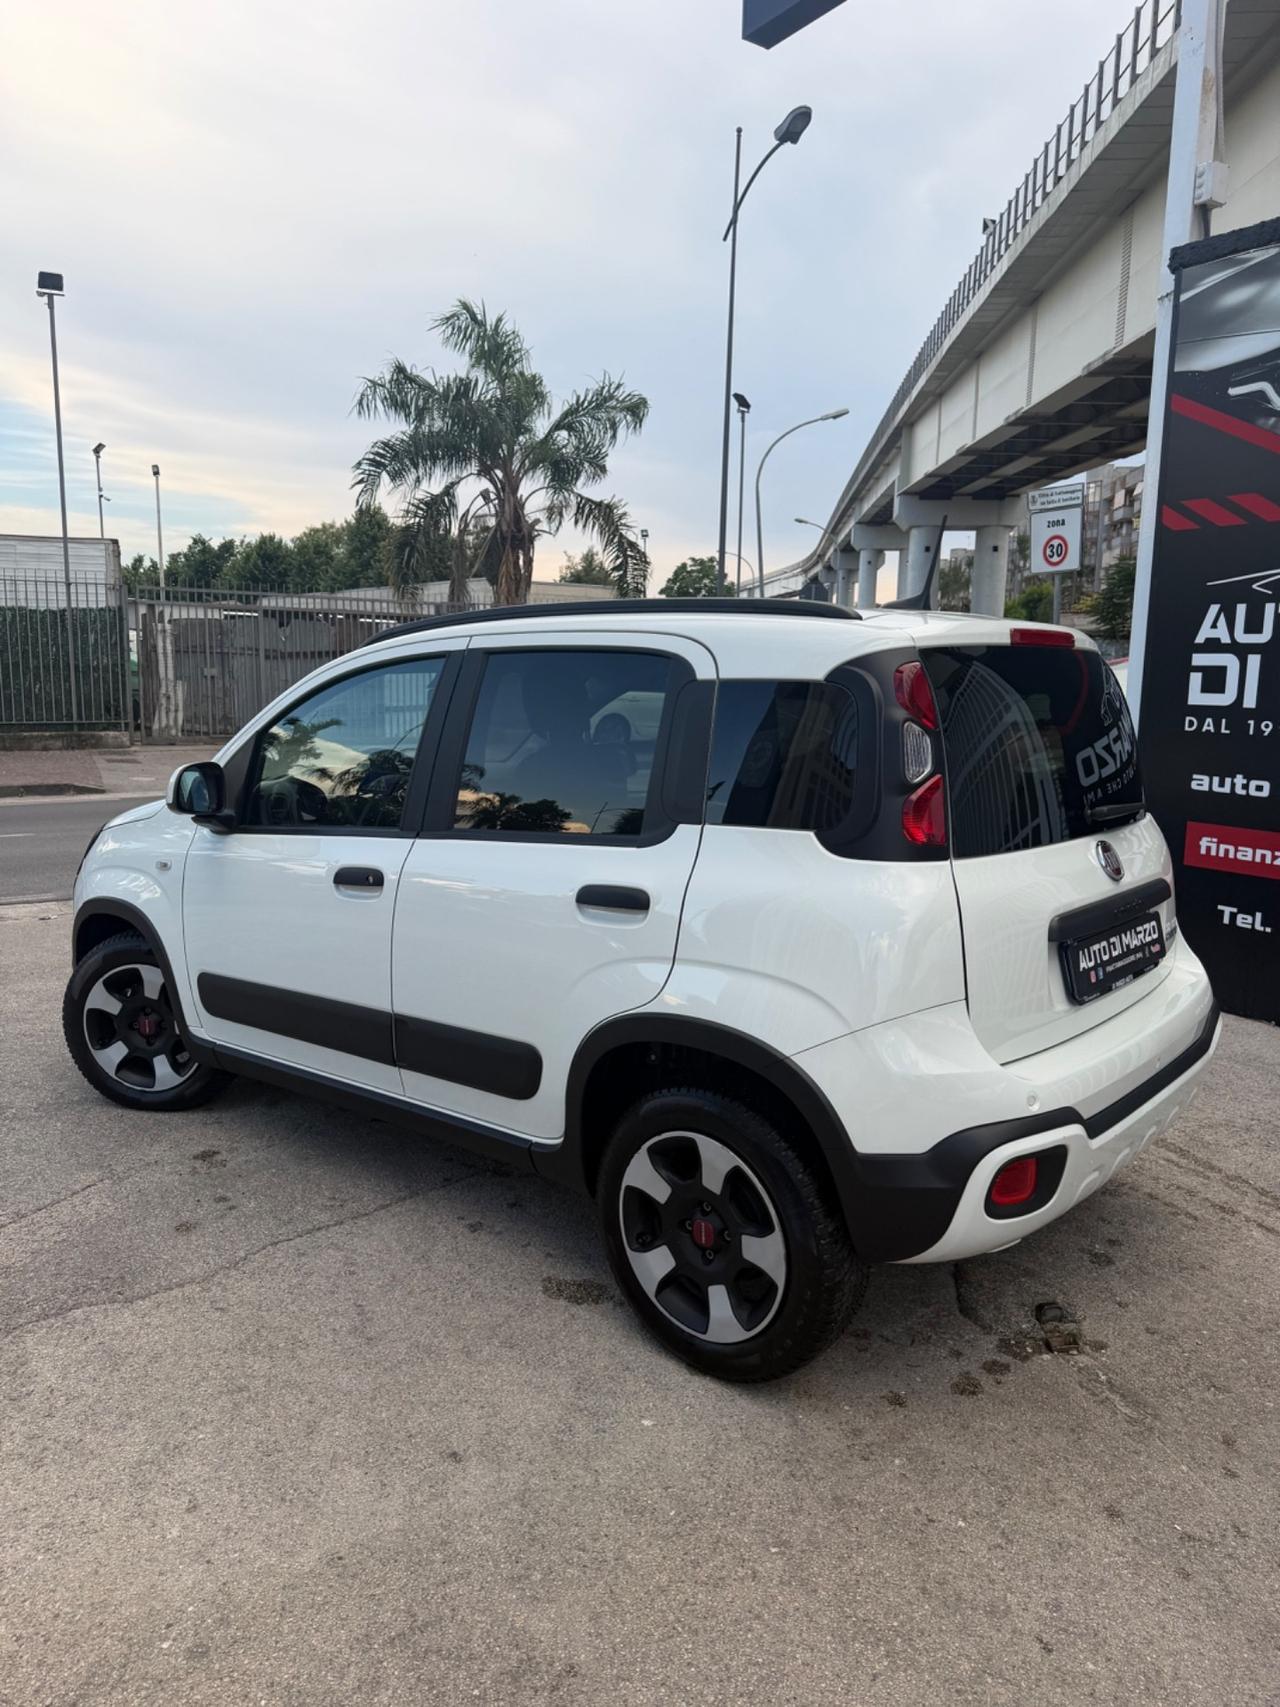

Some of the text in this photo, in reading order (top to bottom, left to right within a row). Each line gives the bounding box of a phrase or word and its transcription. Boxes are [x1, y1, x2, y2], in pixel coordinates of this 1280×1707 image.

[1047, 518, 1066, 528] zona
[1048, 542, 1063, 559] 30
[1194, 602, 1280, 644] AU
[1187, 653, 1262, 709] DI
[1184, 716, 1280, 737] DAL 19
[1191, 774, 1271, 798] auto
[1217, 904, 1272, 933] Tel.
[1079, 940, 1110, 972] AUTO
[1109, 935, 1122, 958] DI
[1121, 920, 1159, 952] MARZO
